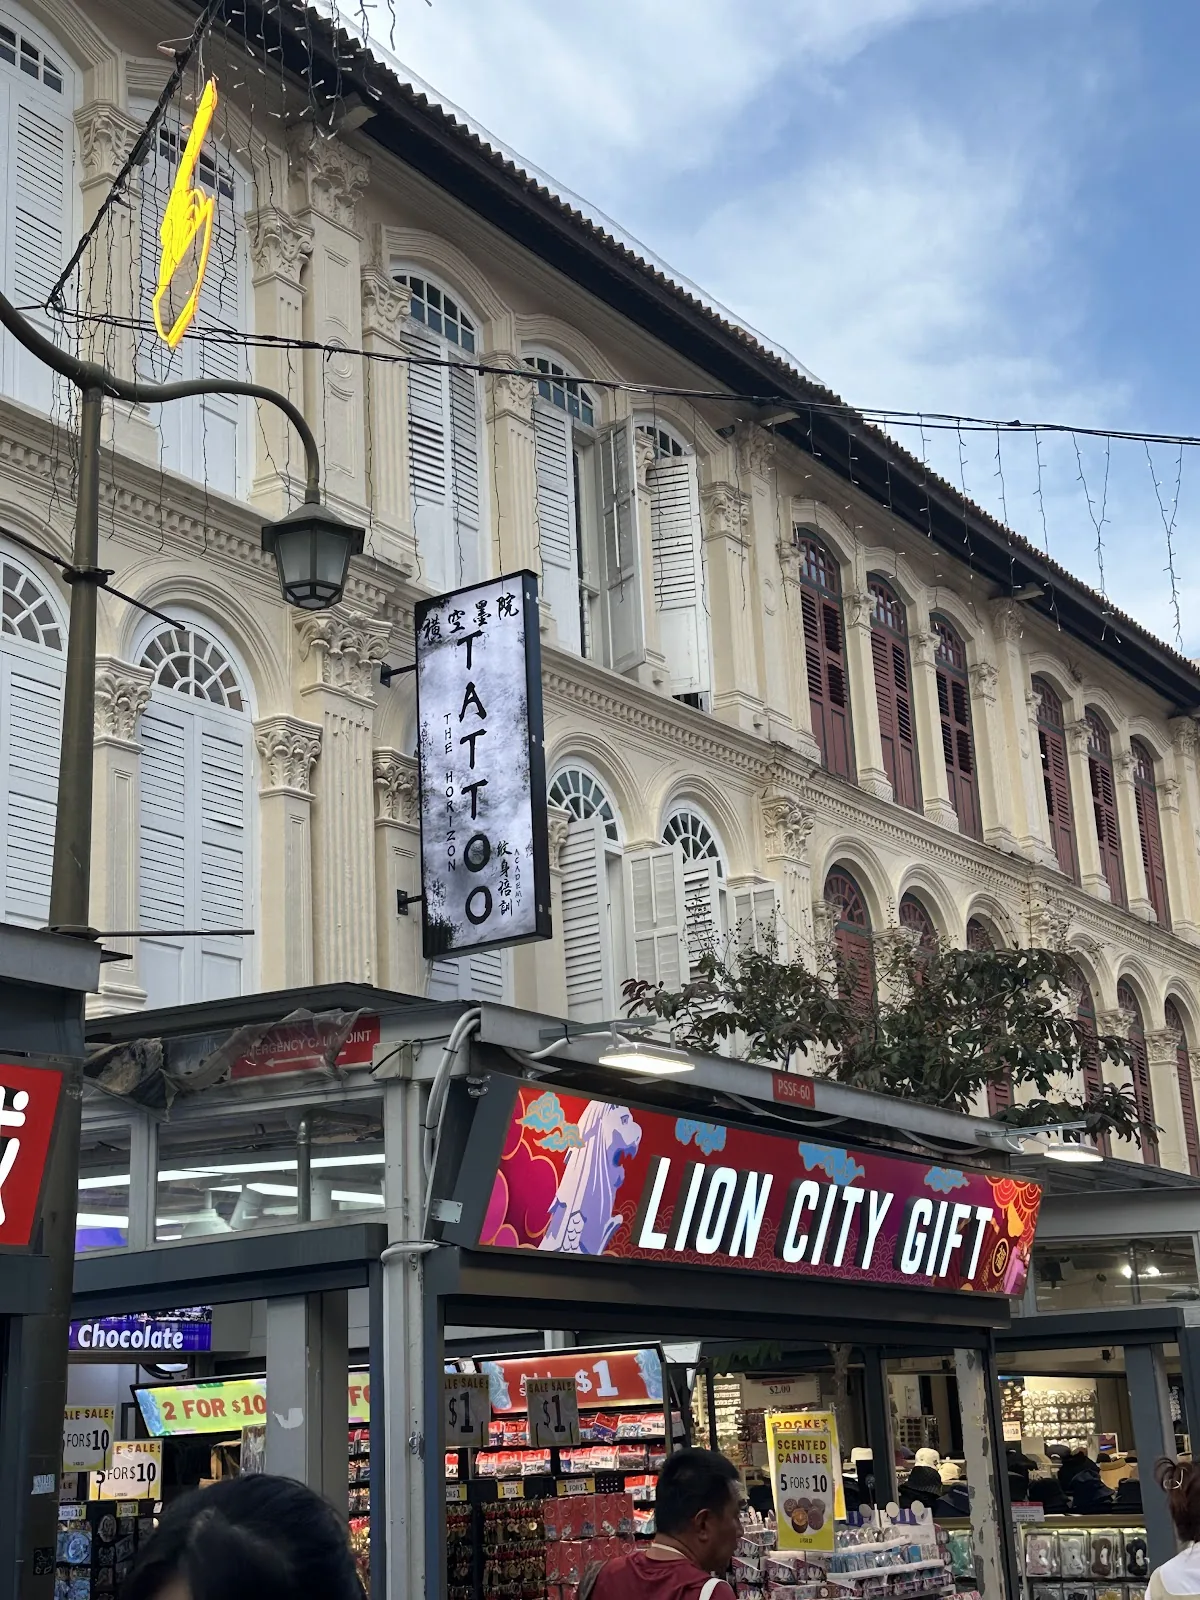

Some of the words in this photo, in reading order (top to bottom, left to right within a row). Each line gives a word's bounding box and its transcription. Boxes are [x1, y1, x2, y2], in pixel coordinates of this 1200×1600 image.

[443, 713, 452, 755] THE
[457, 630, 493, 925] TATTOO
[445, 772, 456, 872] HORIZON
[513, 848, 523, 907] ACADEMY
[346, 1030, 372, 1044] OINT
[778, 1079, 811, 1101] PSSF-60
[638, 1157, 774, 1260] LION
[782, 1179, 895, 1271] CITY
[900, 1198, 994, 1281] GIFT
[77, 1323, 184, 1349] Chocolate
[460, 1377, 484, 1389] SALE
[528, 1382, 549, 1393] SALE
[575, 1359, 619, 1397] $1
[63, 1410, 80, 1420] ALE
[84, 1408, 109, 1419] SALE
[162, 1401, 177, 1421] 2
[182, 1398, 227, 1420] FOR
[232, 1394, 266, 1415] $10
[448, 1391, 474, 1433] $1
[542, 1394, 566, 1433] $1
[127, 1443, 155, 1453] SALE
[777, 1439, 827, 1451] SCENTED
[777, 1452, 828, 1464] CANDLES
[780, 1473, 788, 1491] 5
